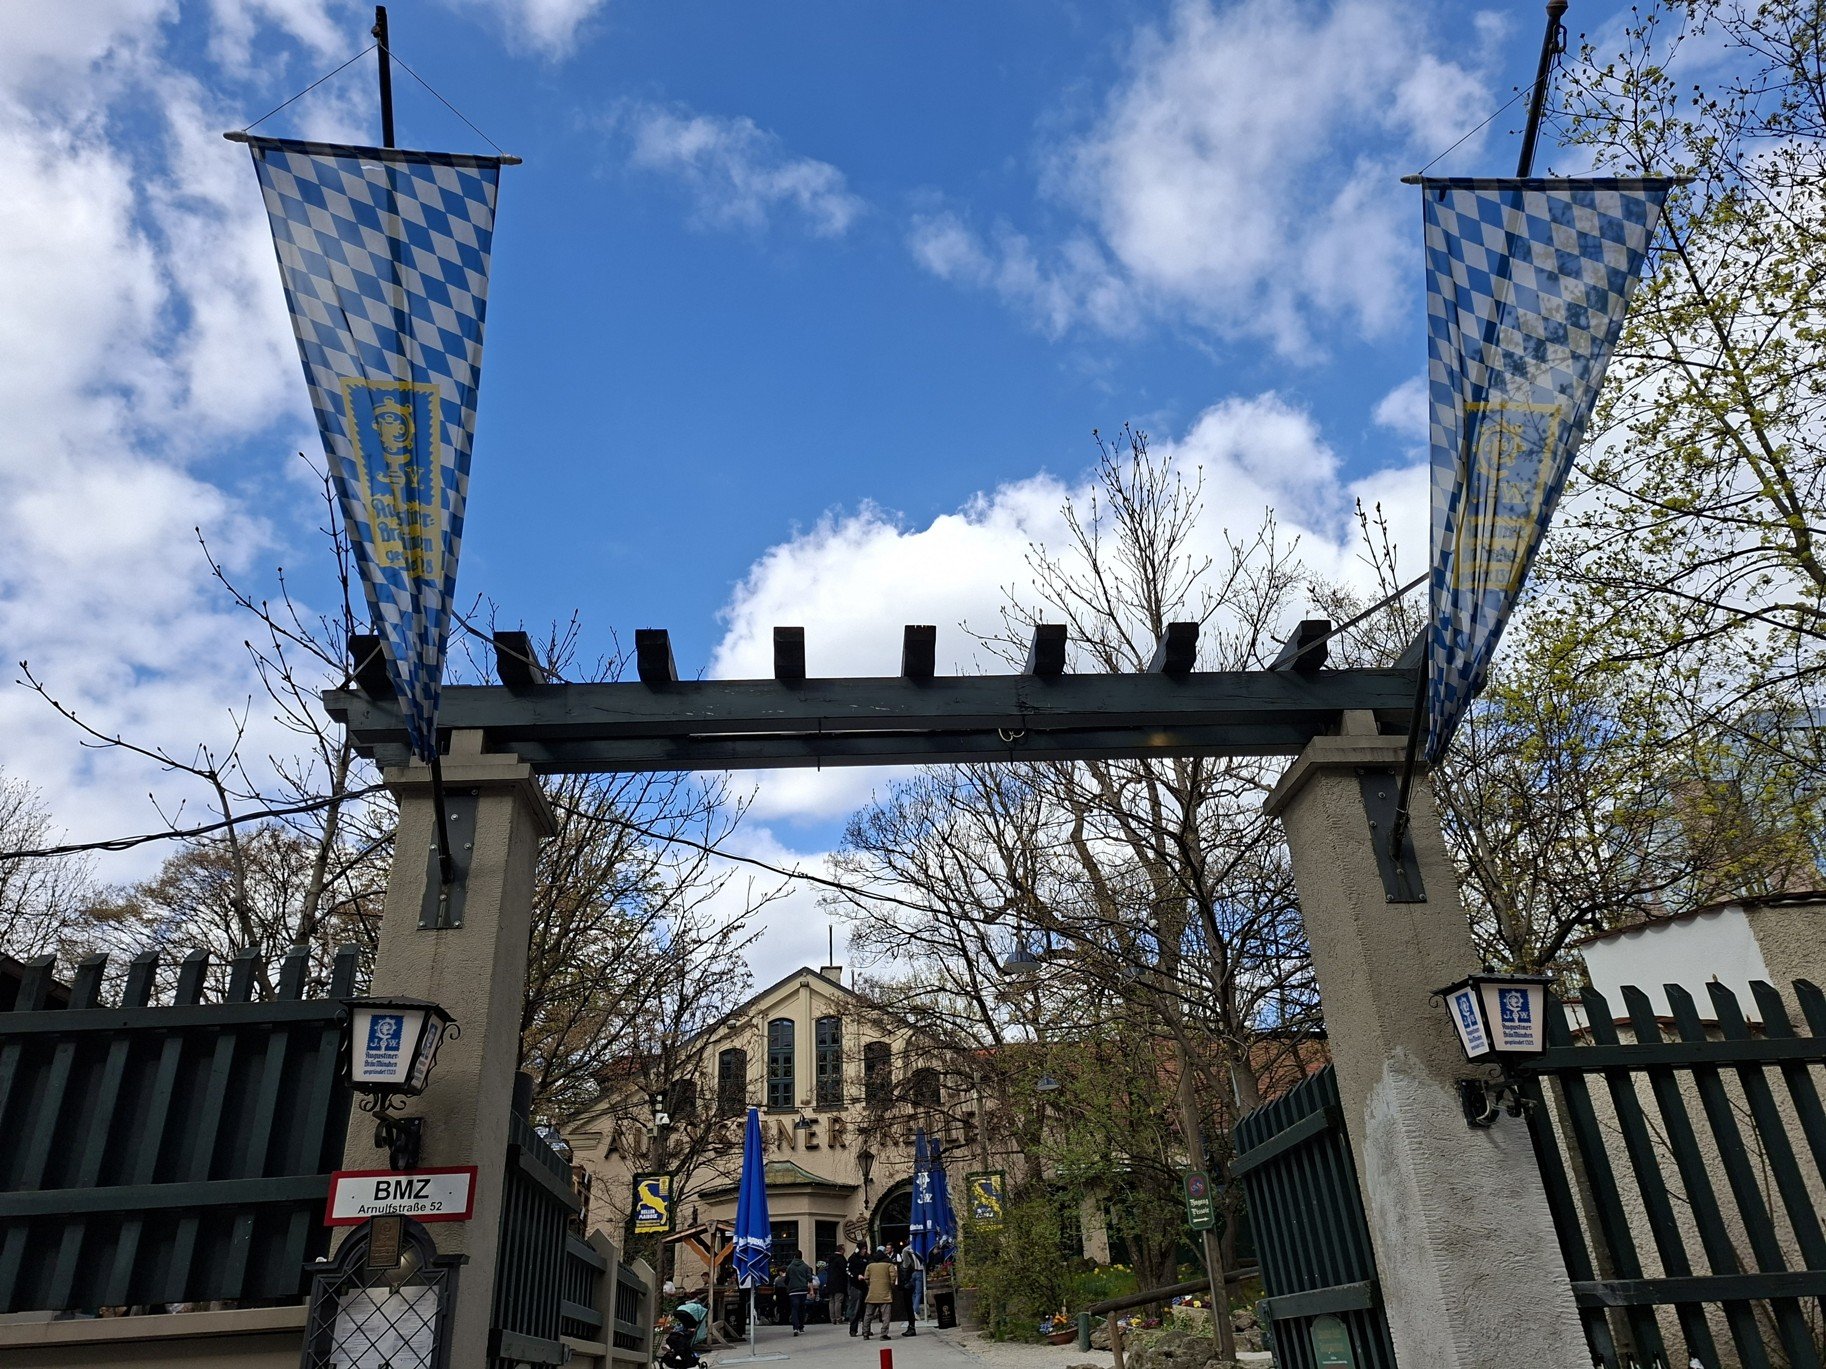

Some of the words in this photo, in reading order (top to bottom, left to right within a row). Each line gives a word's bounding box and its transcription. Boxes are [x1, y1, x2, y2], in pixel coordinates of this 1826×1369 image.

[604, 1116, 846, 1160] AUSINER
[373, 1178, 431, 1201] BMZ
[357, 1202, 427, 1214] Arnulfstraße
[429, 1201, 443, 1211] 52
